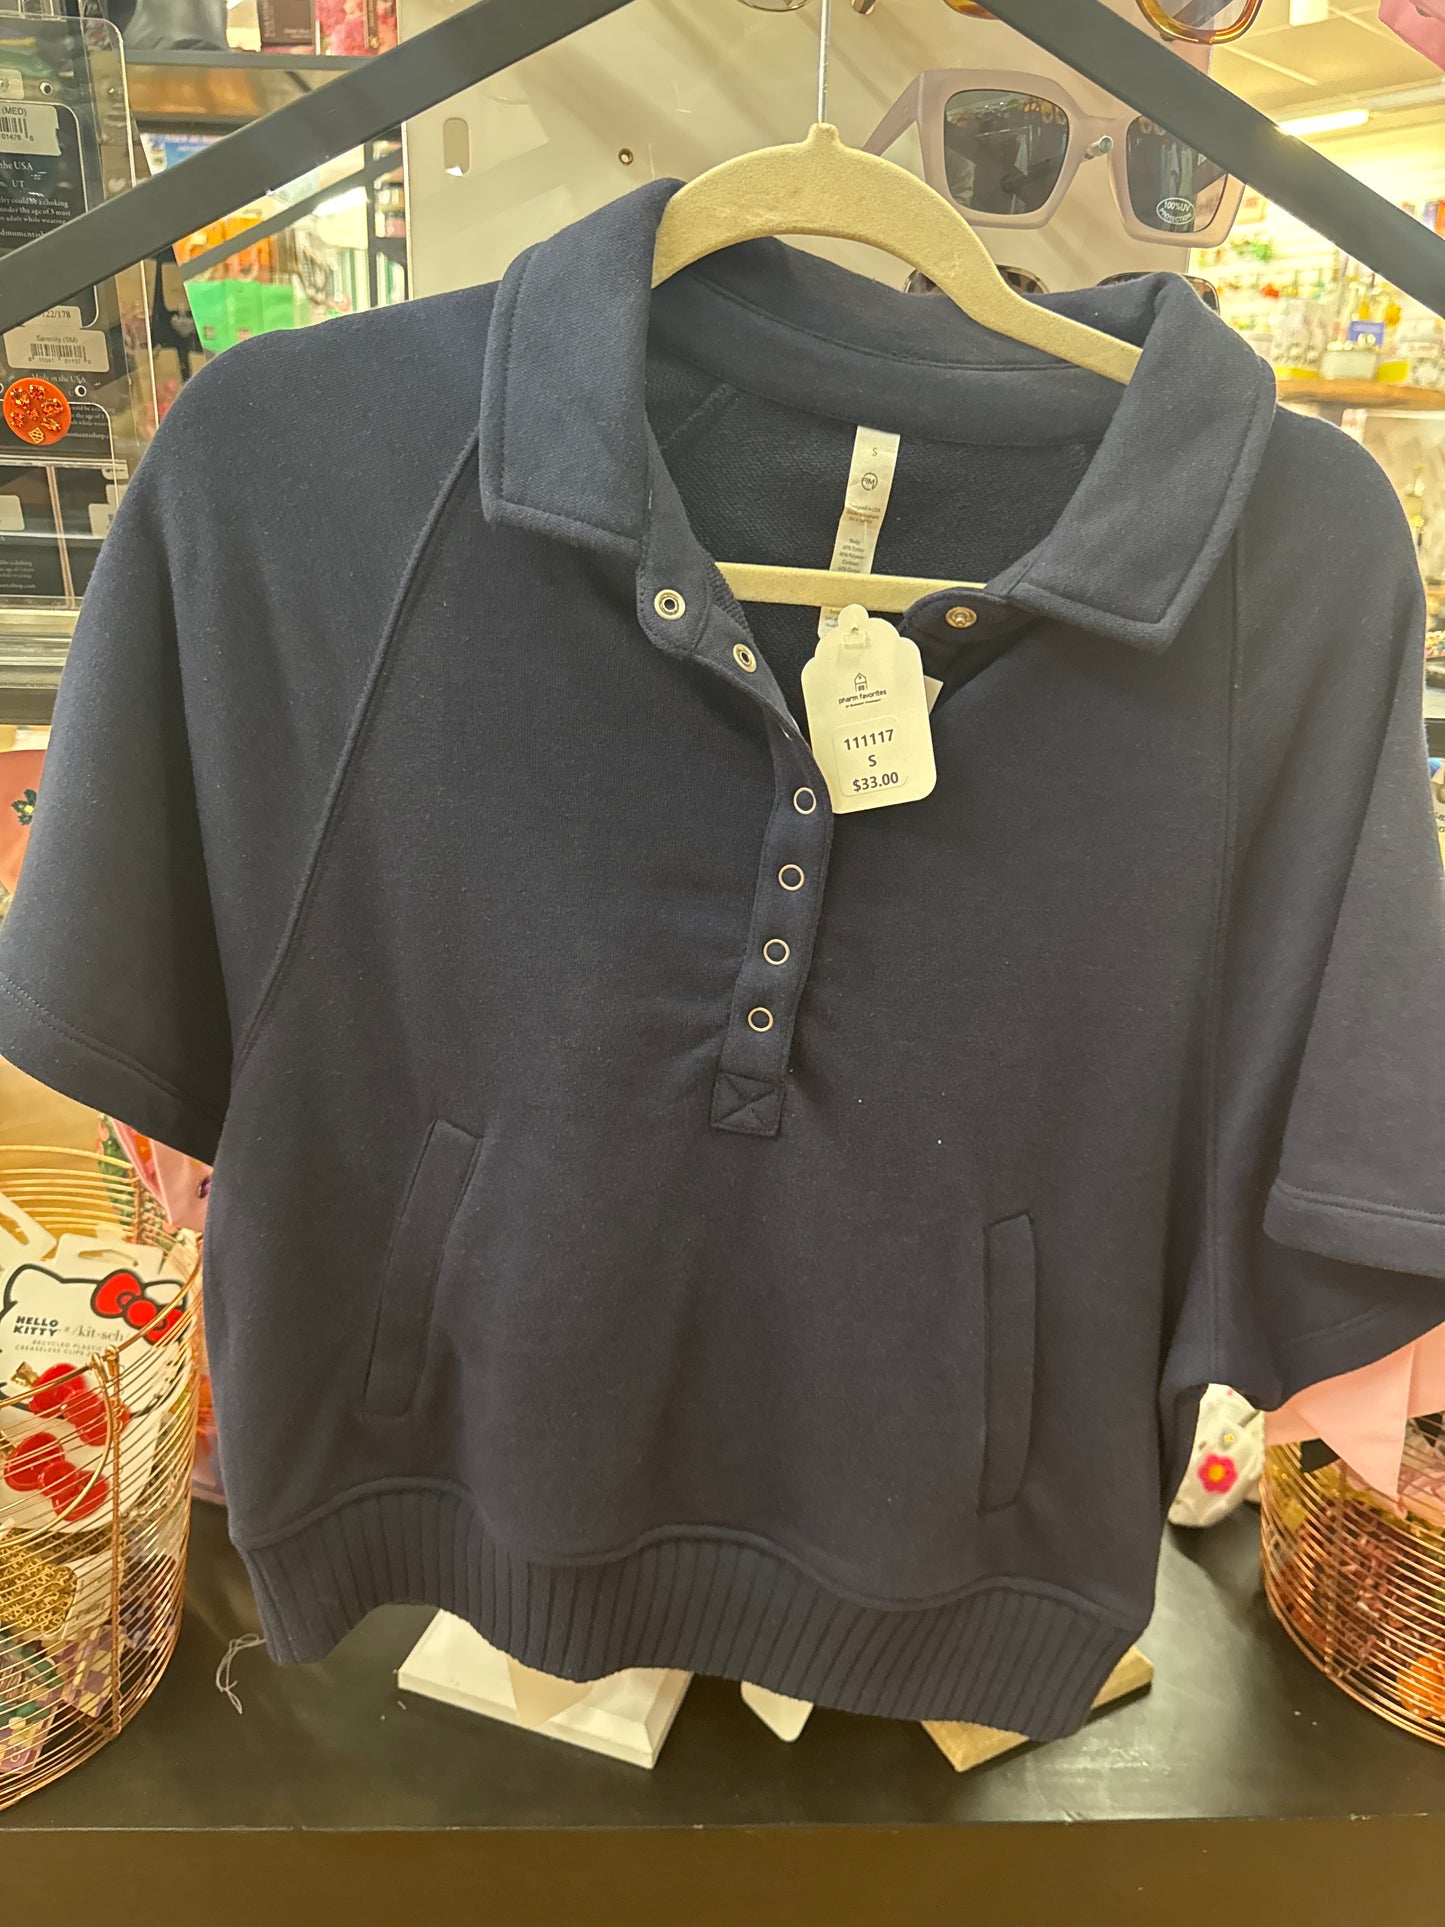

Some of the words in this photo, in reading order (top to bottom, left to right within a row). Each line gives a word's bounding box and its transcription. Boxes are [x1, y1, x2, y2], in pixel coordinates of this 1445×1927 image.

[1, 106, 27, 117] (MED)
[14, 161, 34, 171] USA
[12, 180, 25, 188] UT
[43, 198, 69, 209] choking
[69, 375, 87, 384] USA
[871, 446, 879, 458] S
[838, 695, 858, 704] pharm
[859, 689, 887, 699] favorites
[844, 728, 894, 751] 111117
[868, 754, 877, 768] S
[852, 771, 899, 793] $33.00
[16, 1315, 59, 1328] HELLO
[13, 1325, 58, 1337] KITTY
[15, 1344, 61, 1354] CREASELESS
